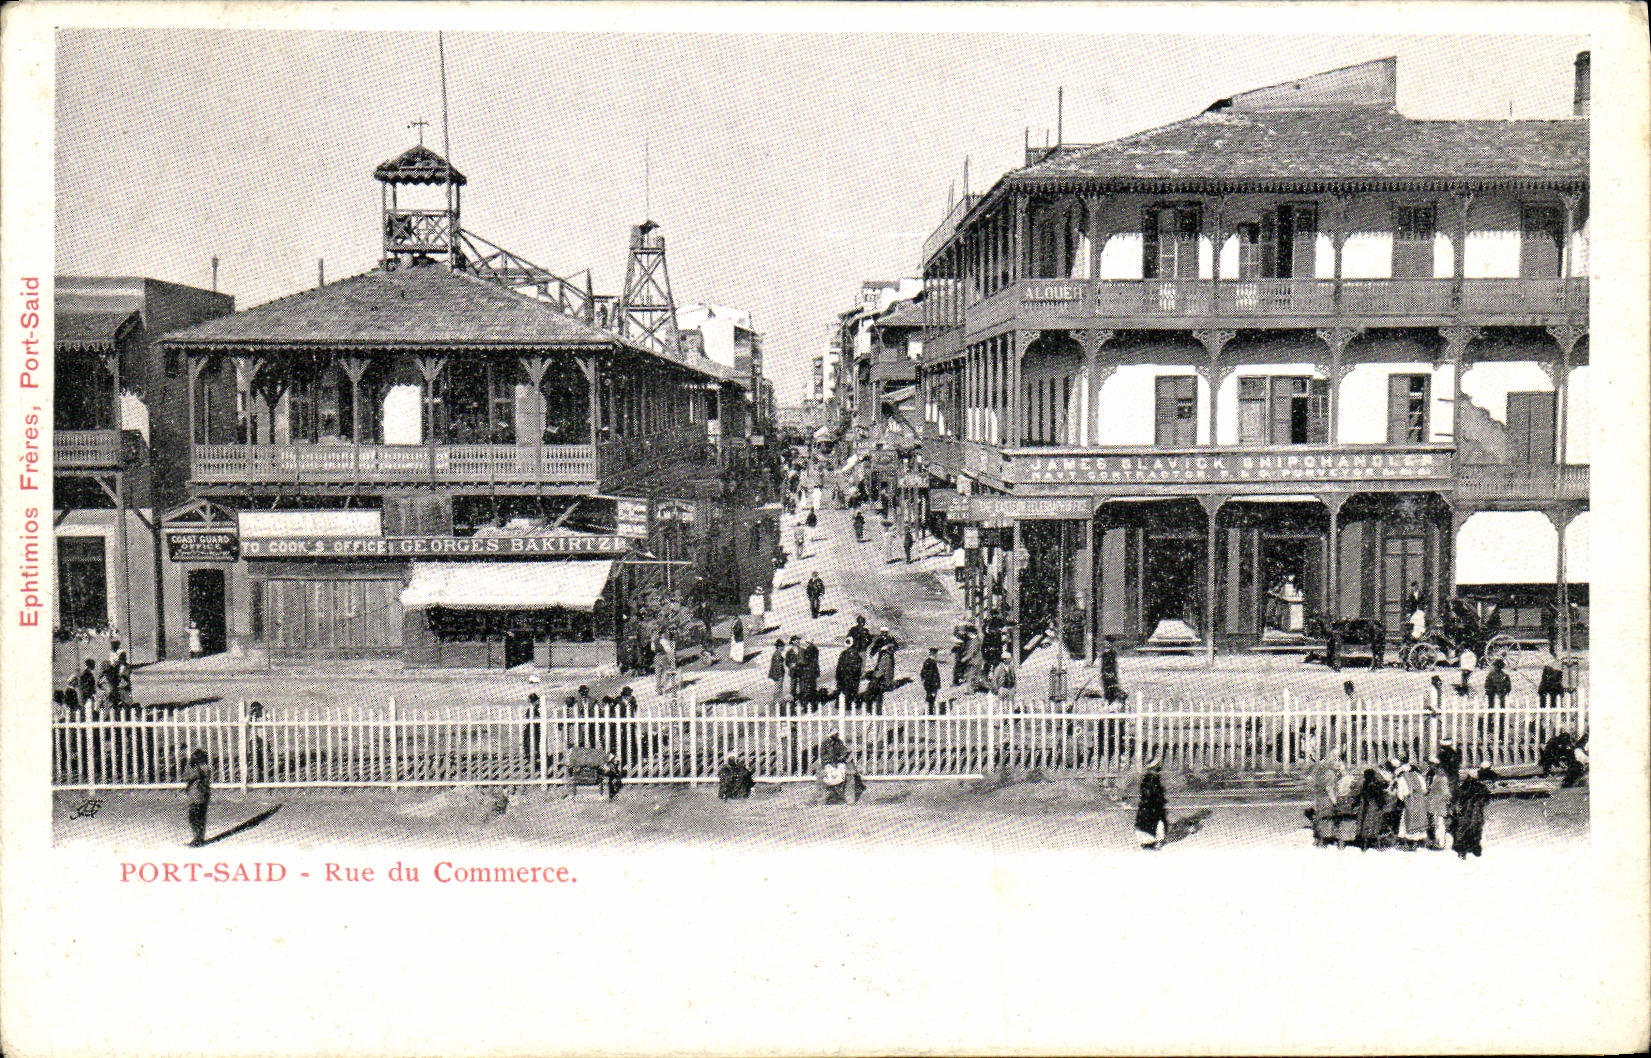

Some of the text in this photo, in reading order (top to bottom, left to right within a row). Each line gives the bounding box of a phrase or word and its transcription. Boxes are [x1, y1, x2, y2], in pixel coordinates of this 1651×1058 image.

[1031, 457, 1107, 470] JAMES
[171, 535, 230, 543] COAST GUARD
[400, 538, 499, 553] GEORGES
[241, 541, 260, 553] TO
[333, 540, 386, 554] OFFICE
